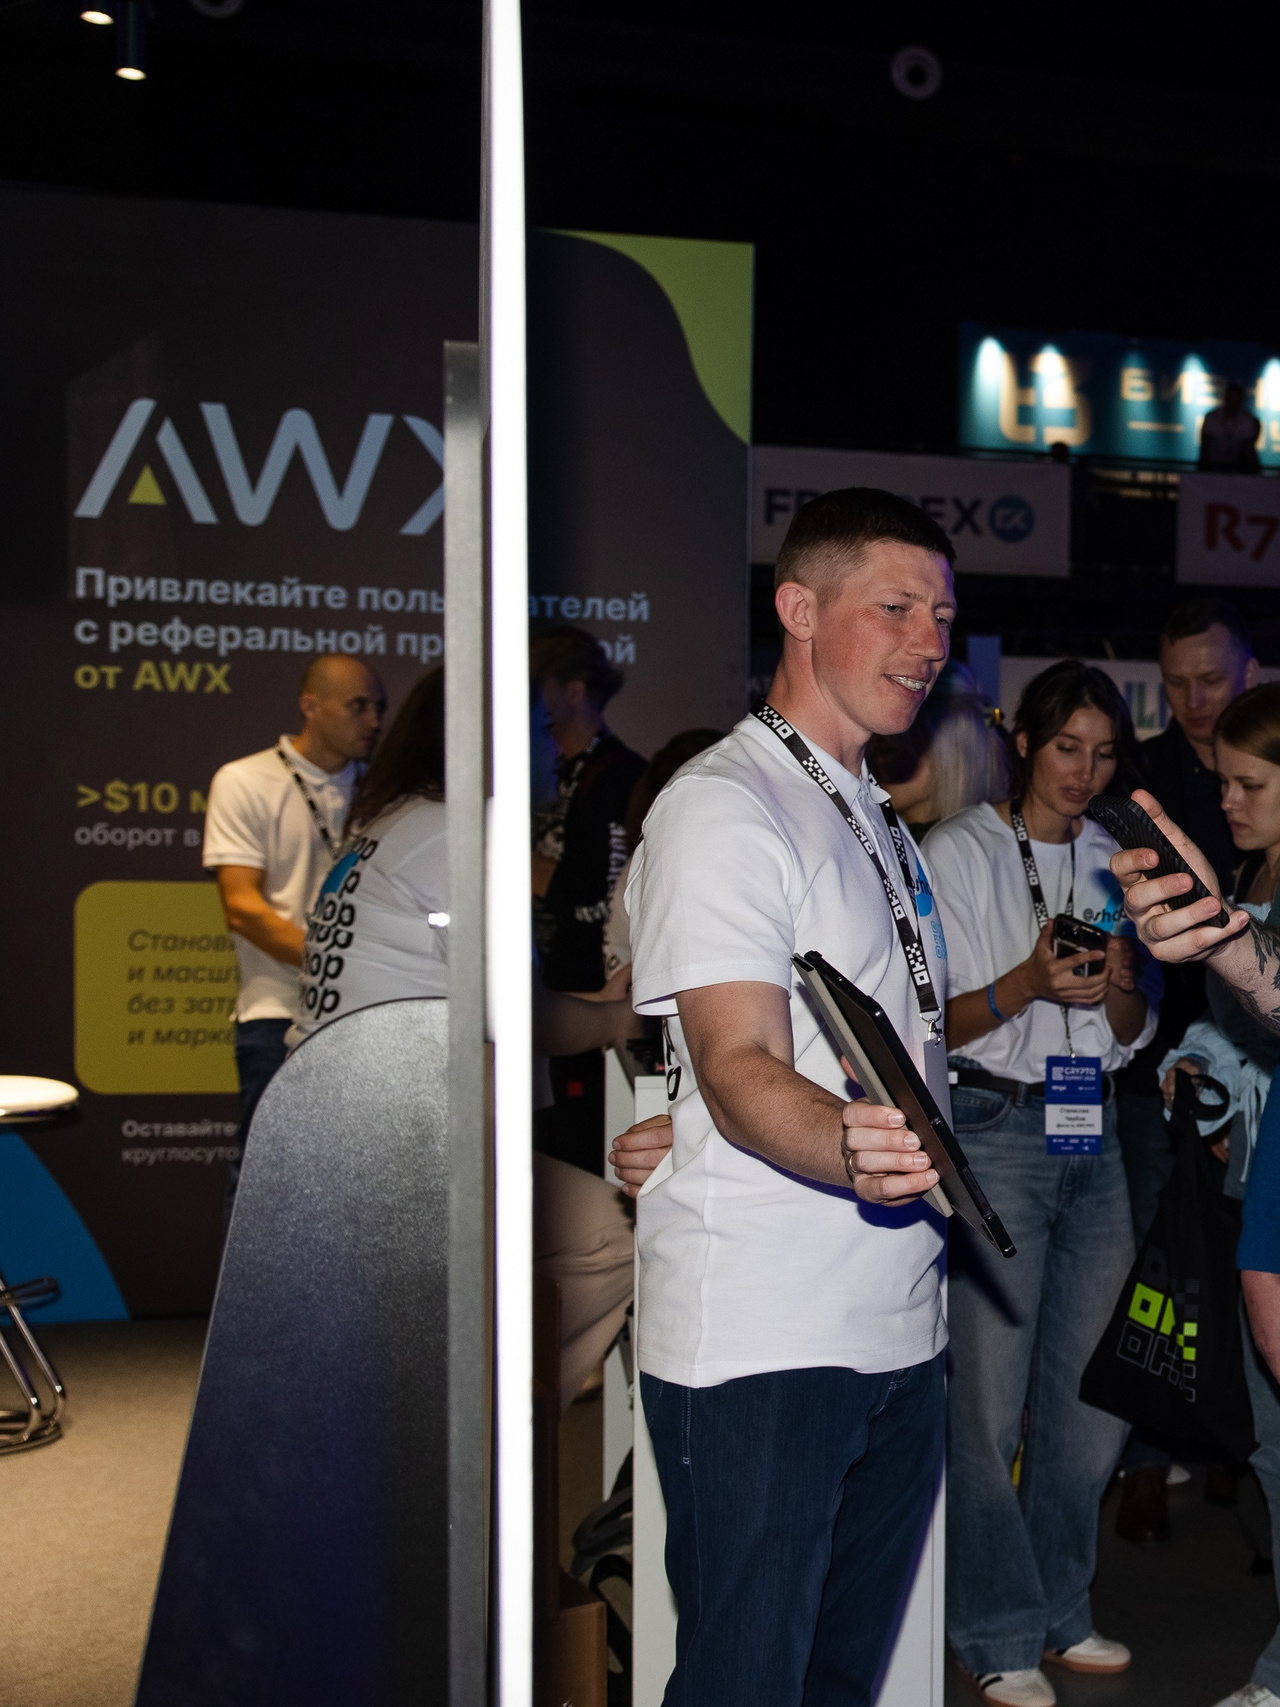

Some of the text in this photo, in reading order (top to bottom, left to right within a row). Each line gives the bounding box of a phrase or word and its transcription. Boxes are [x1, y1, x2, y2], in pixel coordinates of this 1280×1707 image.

[75, 566, 348, 607] Привлекайте
[109, 616, 387, 658] реферальной
[74, 660, 232, 695] от AWX
[76, 779, 180, 815] >$10
[74, 822, 177, 851] оборот
[127, 994, 176, 1015] без
